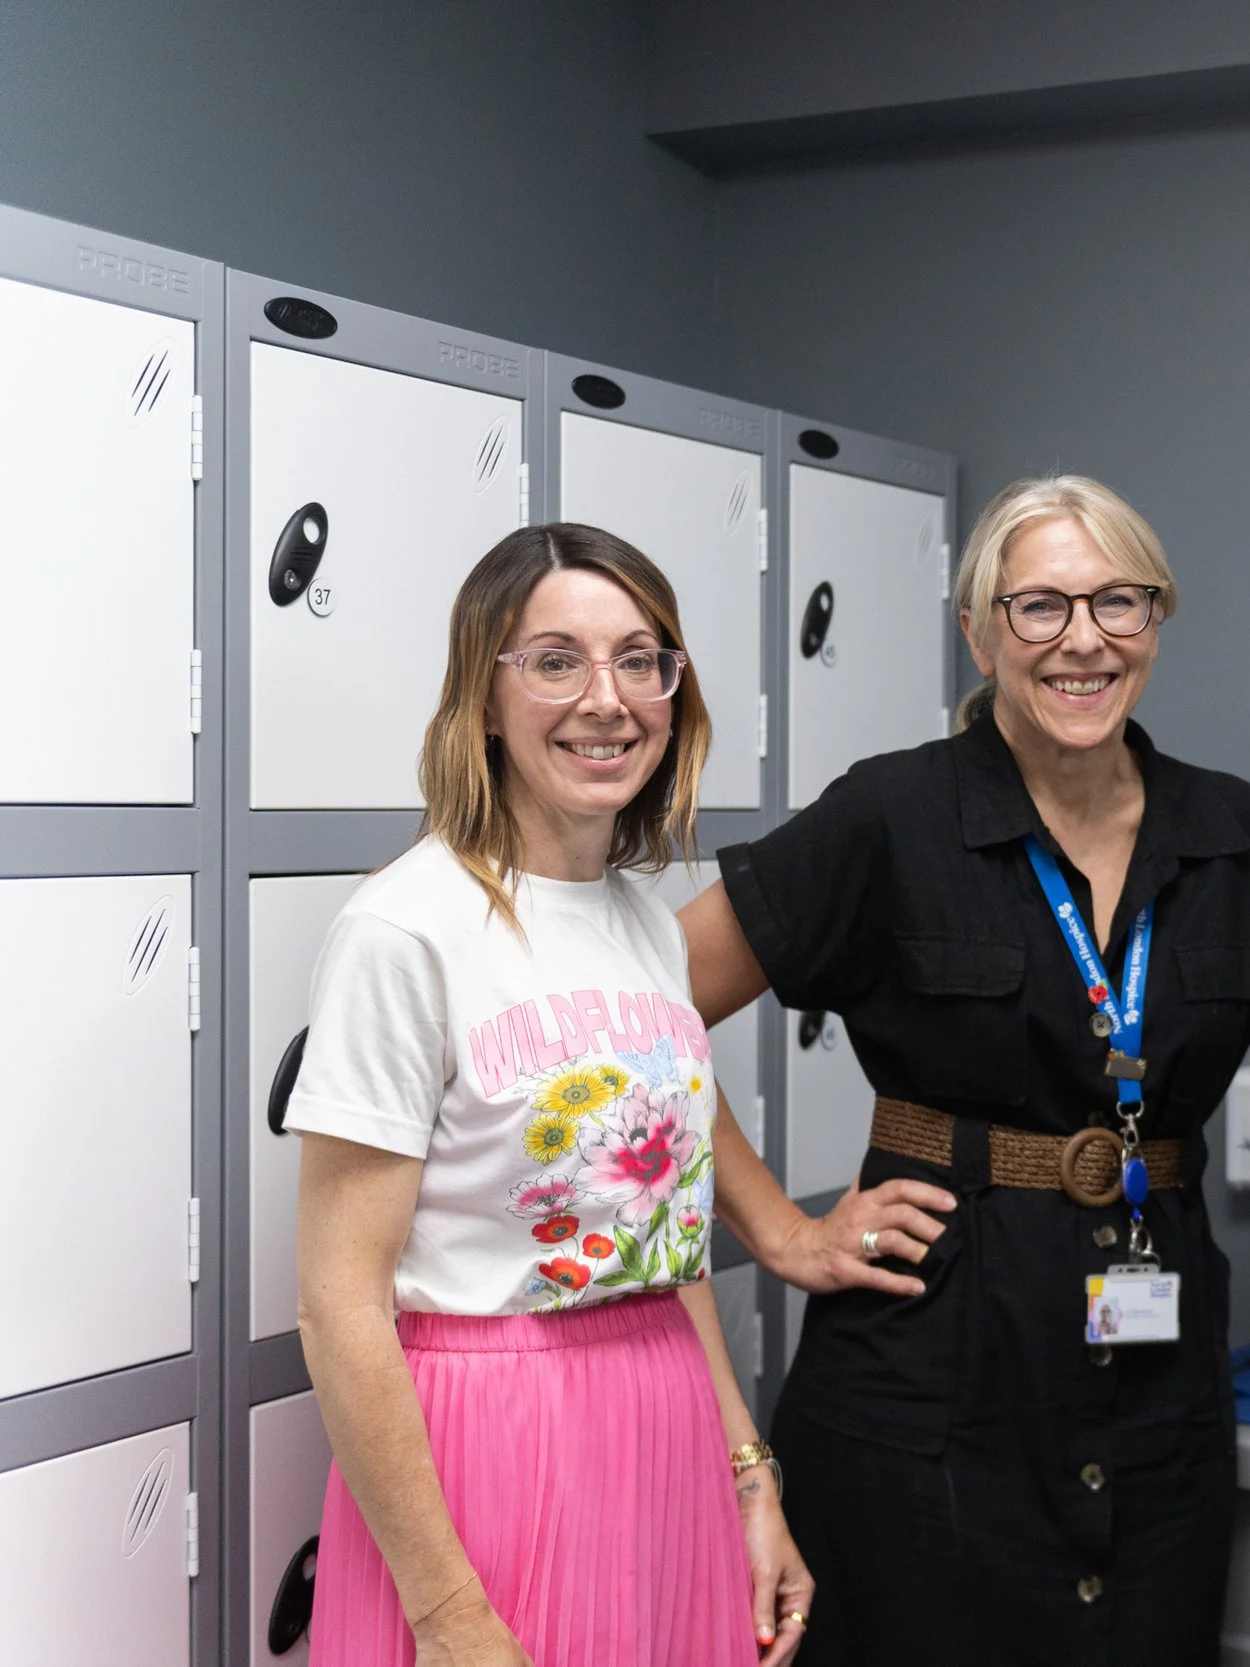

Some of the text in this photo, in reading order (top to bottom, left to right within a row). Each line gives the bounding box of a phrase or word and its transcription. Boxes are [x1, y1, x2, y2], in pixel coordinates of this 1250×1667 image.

[75, 244, 190, 295] PROBE
[437, 340, 520, 379] PROBE
[315, 588, 331, 605] 37
[1126, 966, 1142, 1010] Hospice
